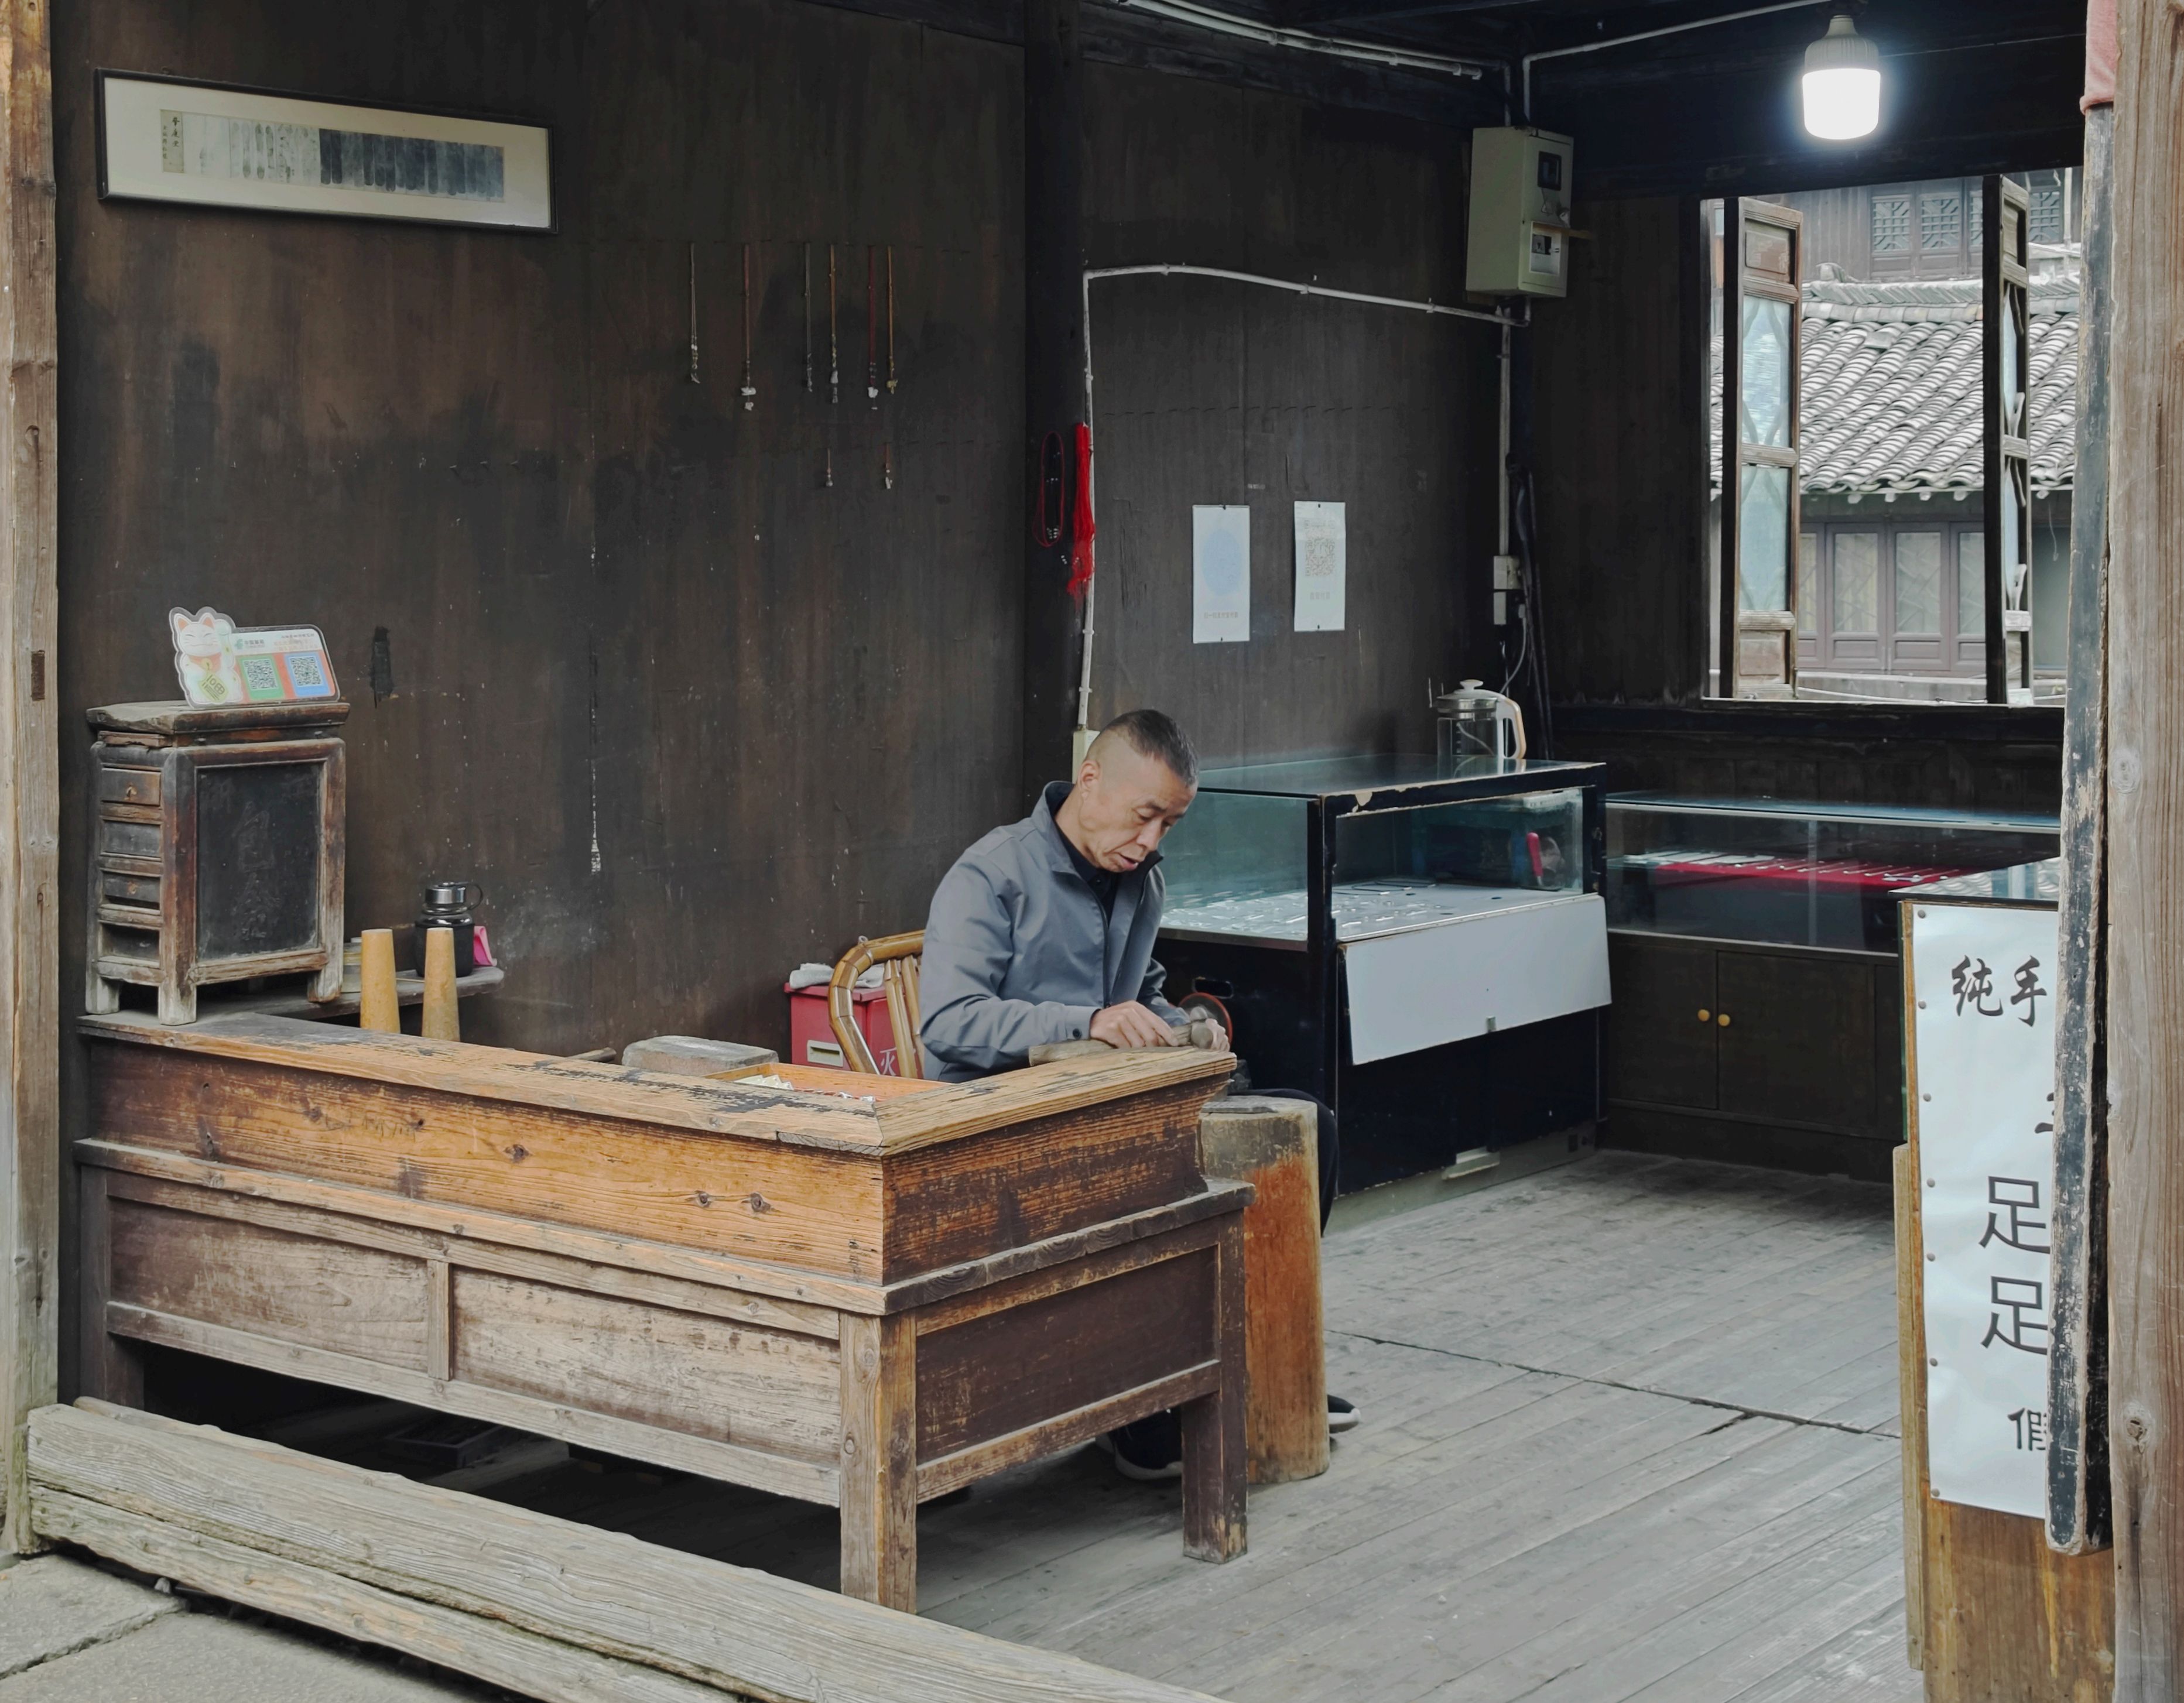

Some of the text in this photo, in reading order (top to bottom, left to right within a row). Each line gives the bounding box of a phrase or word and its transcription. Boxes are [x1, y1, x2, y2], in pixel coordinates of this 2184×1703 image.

[1952, 955, 2047, 1027] 纯手
[879, 1046, 898, 1076] 灭
[1979, 1176, 2051, 1254] 足
[1981, 1276, 2048, 1355] 足
